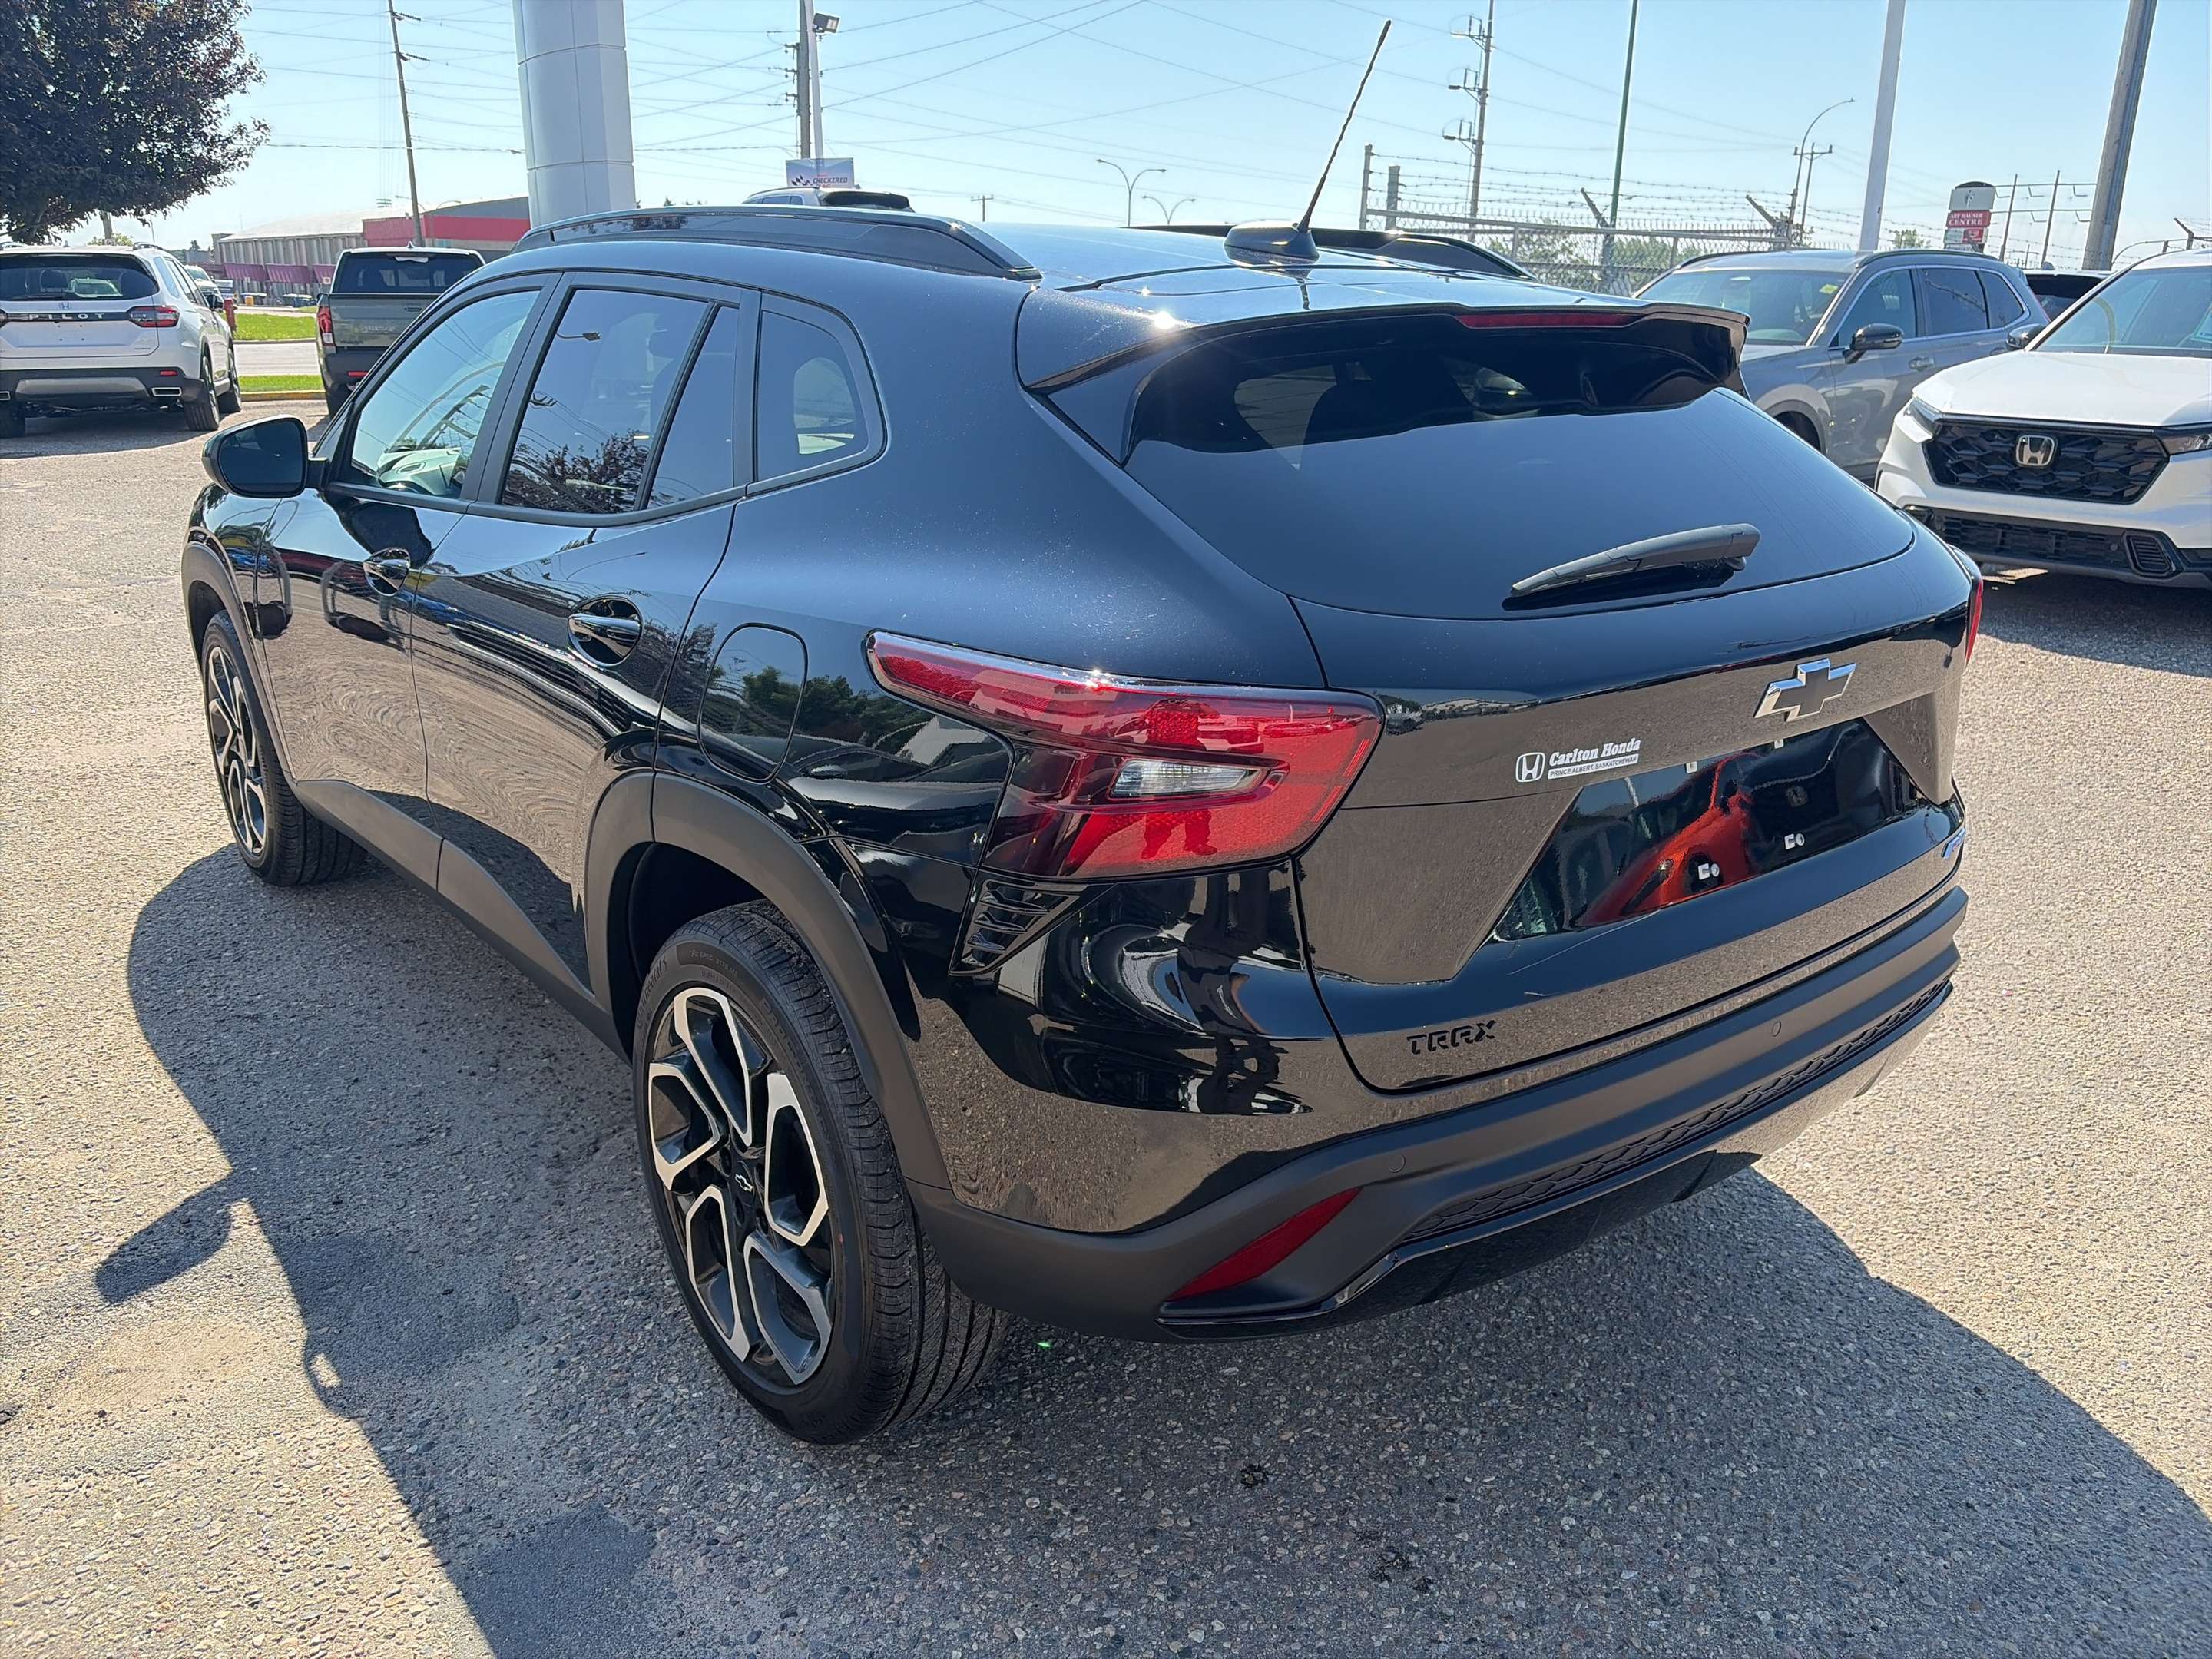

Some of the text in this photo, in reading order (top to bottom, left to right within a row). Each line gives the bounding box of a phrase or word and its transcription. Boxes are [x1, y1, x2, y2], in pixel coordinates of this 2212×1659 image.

[1549, 748, 1598, 767] Carlton
[1601, 737, 1641, 757] Honda
[1550, 756, 1637, 777] PRINCE ALBERT, SASKATCHEWAN
[1406, 1019, 1497, 1055] TRAX
